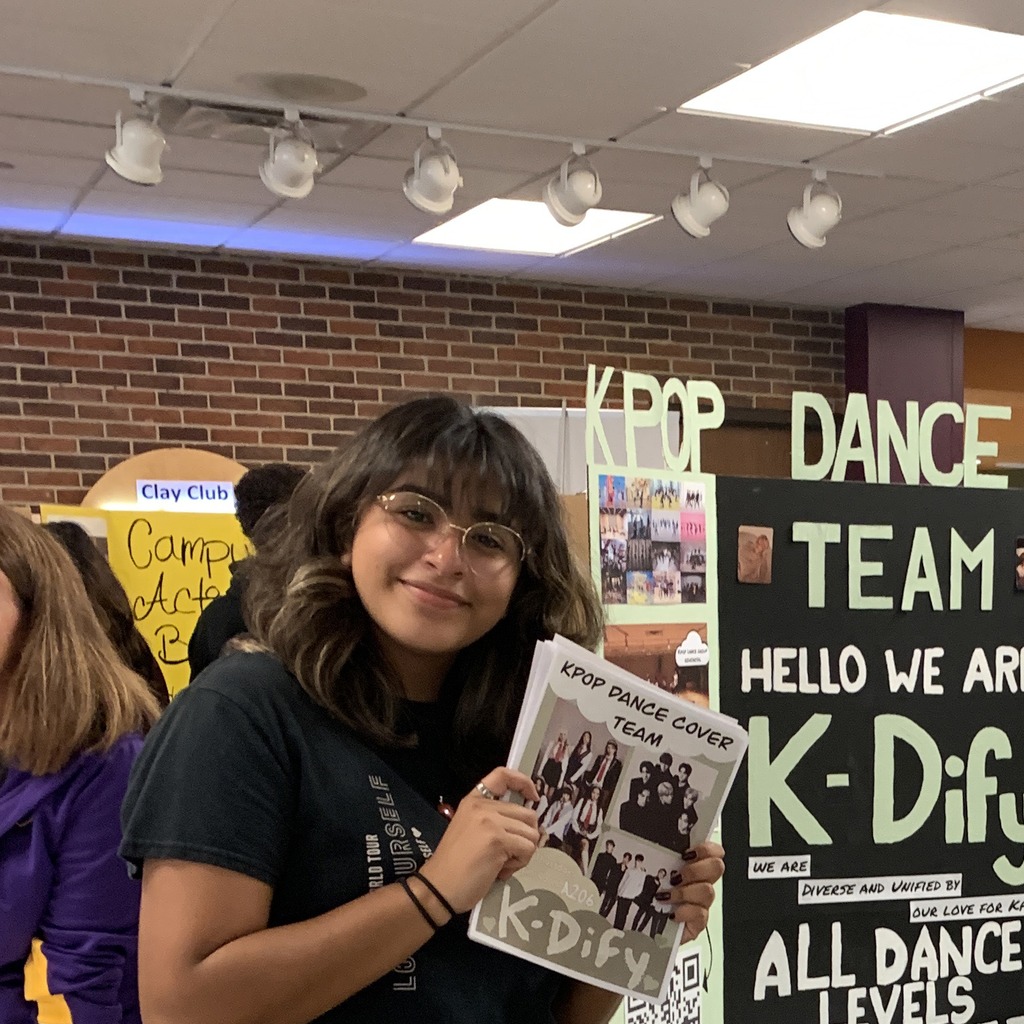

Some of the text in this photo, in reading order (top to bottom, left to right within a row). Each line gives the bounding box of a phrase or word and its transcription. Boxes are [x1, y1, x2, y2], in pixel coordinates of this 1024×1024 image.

[584, 364, 725, 474] KPOP
[791, 390, 1012, 489] DANCE
[141, 484, 229, 503] Clay Club
[128, 518, 250, 579] Campu
[792, 521, 995, 612] TEAM
[741, 644, 867, 694] HELLO
[884, 647, 944, 695] WE
[559, 660, 735, 751] KPOP DANCE COVER
[612, 715, 664, 748] TEAM
[365, 834, 382, 863] TOUR
[752, 860, 809, 874] WE ARE
[561, 880, 594, 907] A206
[802, 878, 961, 897] DIVERSE AND UNIFIED BY
[912, 905, 939, 919] OUR
[943, 903, 976, 917] LOVE
[979, 901, 1003, 915] FOR
[753, 919, 1023, 1001] ALL DANCE
